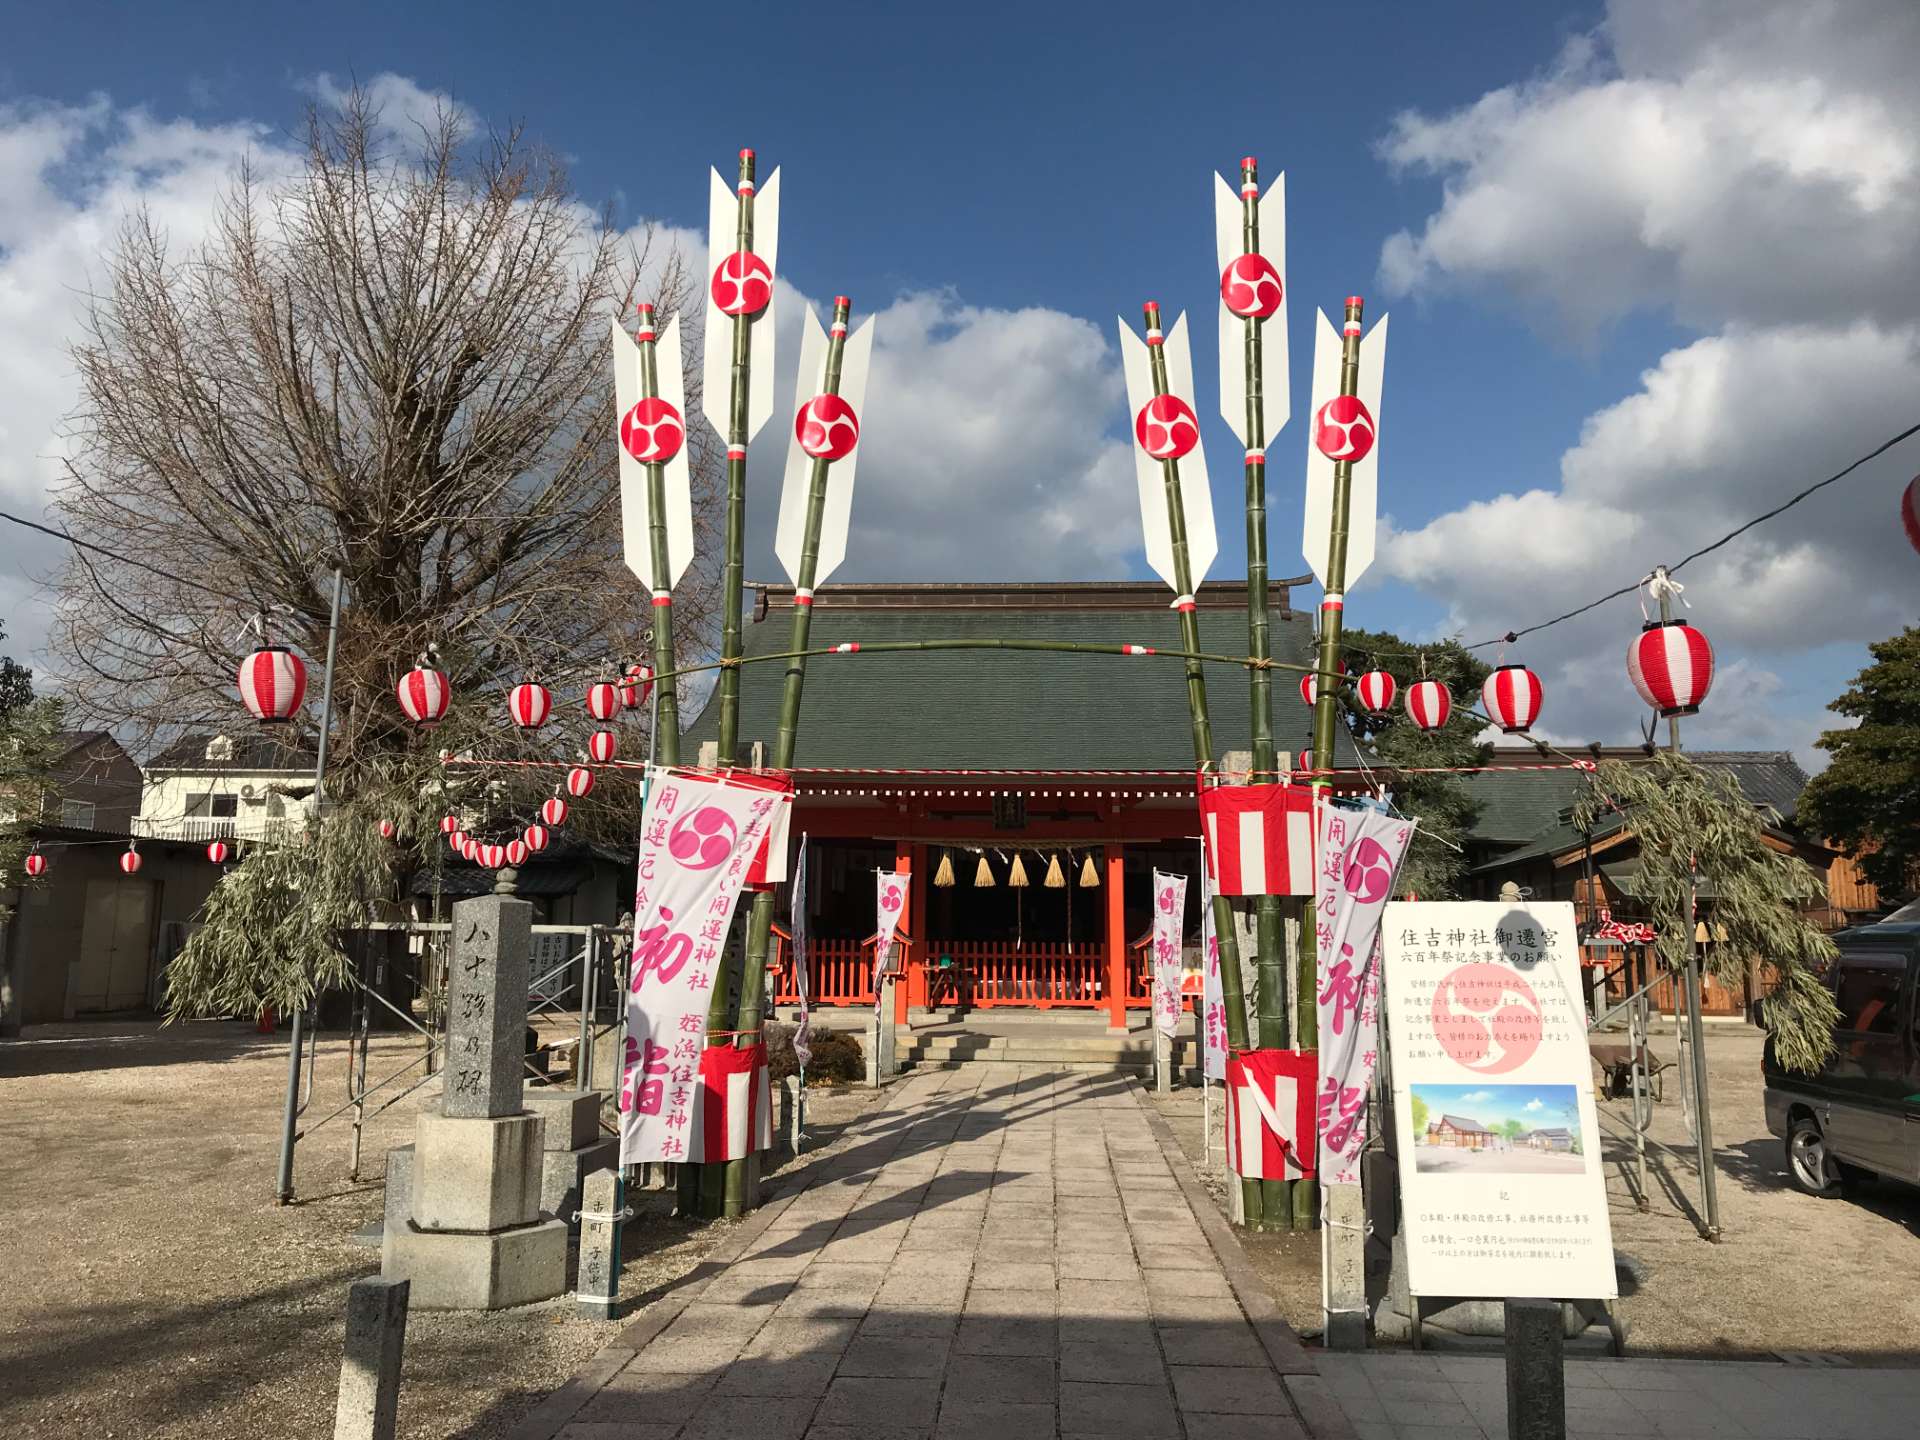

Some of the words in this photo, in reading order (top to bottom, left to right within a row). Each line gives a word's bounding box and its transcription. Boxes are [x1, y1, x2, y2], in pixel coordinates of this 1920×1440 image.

[1400, 927, 1559, 949] 住吉神社御遷宮
[1401, 951, 1562, 964] 六百年祭記念事業のお願い
[661, 1012, 704, 1158] 姪浜住吉神社
[1499, 1190, 1511, 1201] 記
